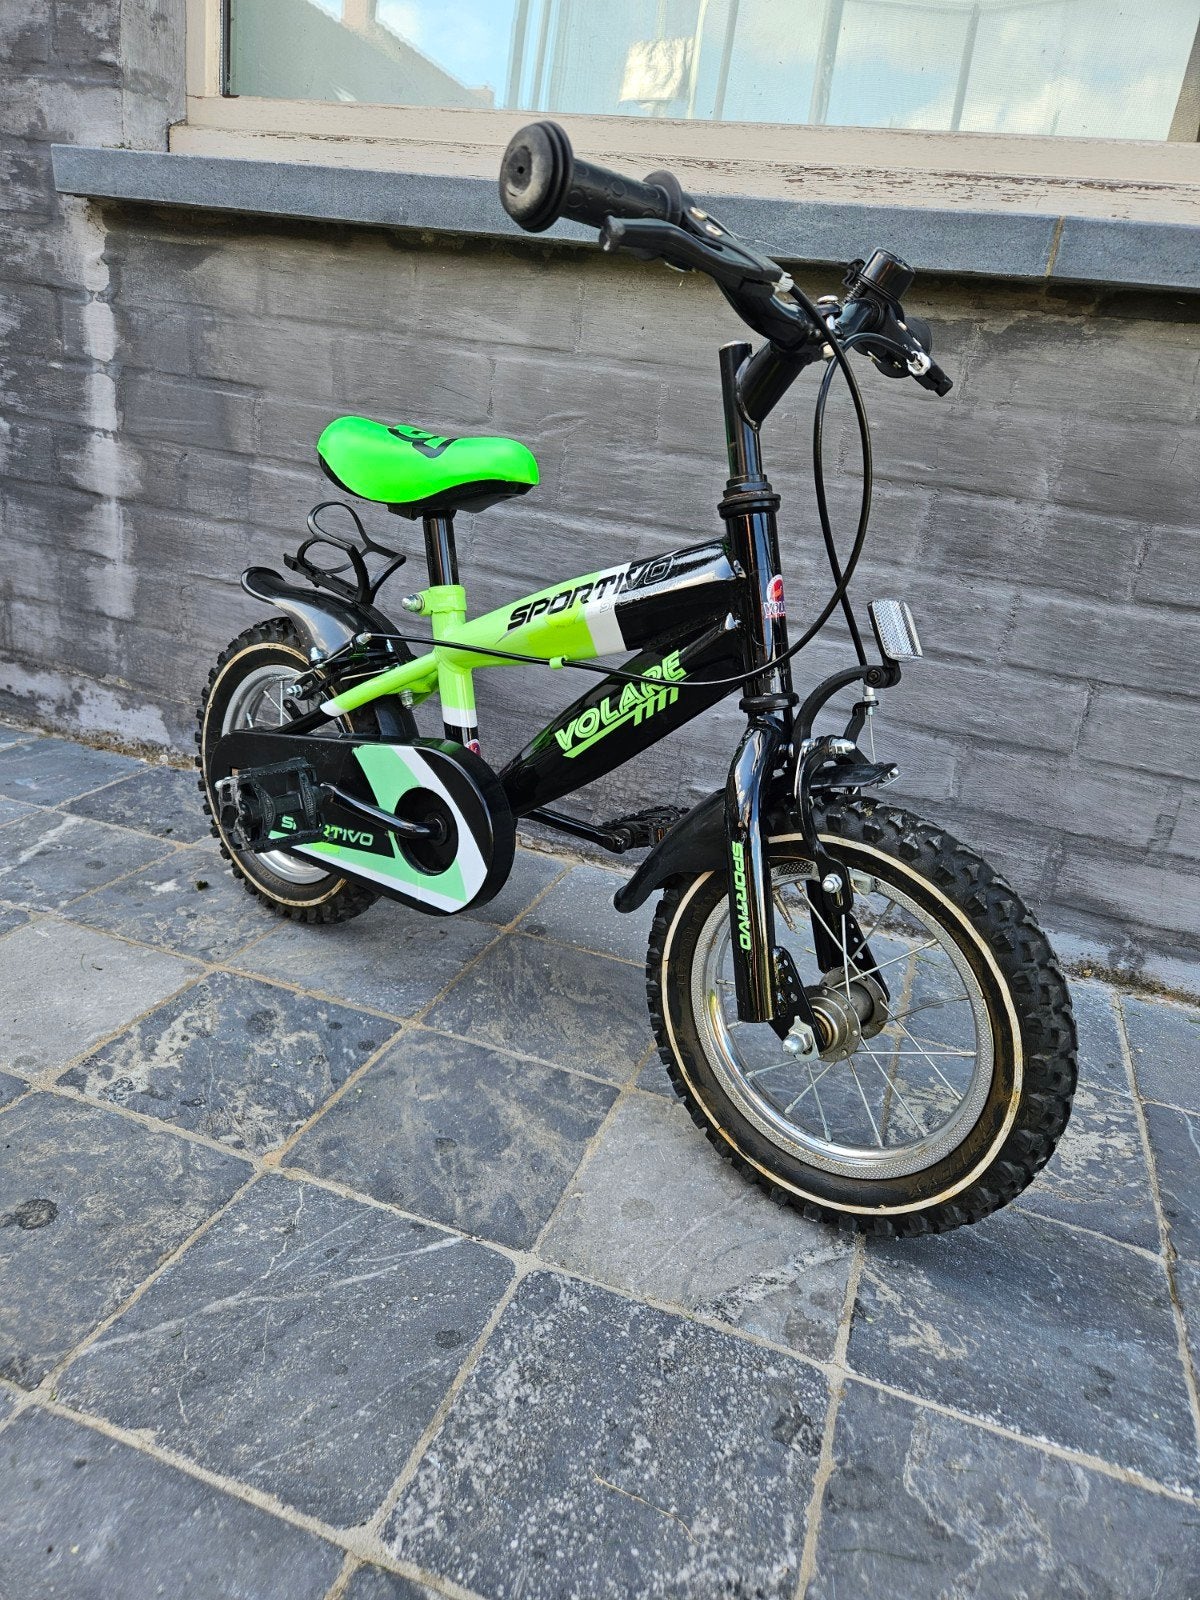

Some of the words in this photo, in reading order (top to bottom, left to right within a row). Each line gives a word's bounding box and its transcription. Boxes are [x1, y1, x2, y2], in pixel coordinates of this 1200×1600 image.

[507, 555, 675, 632] SPORTIVO
[554, 649, 687, 752] VOLARE
[731, 840, 752, 951] SPORTIVO
